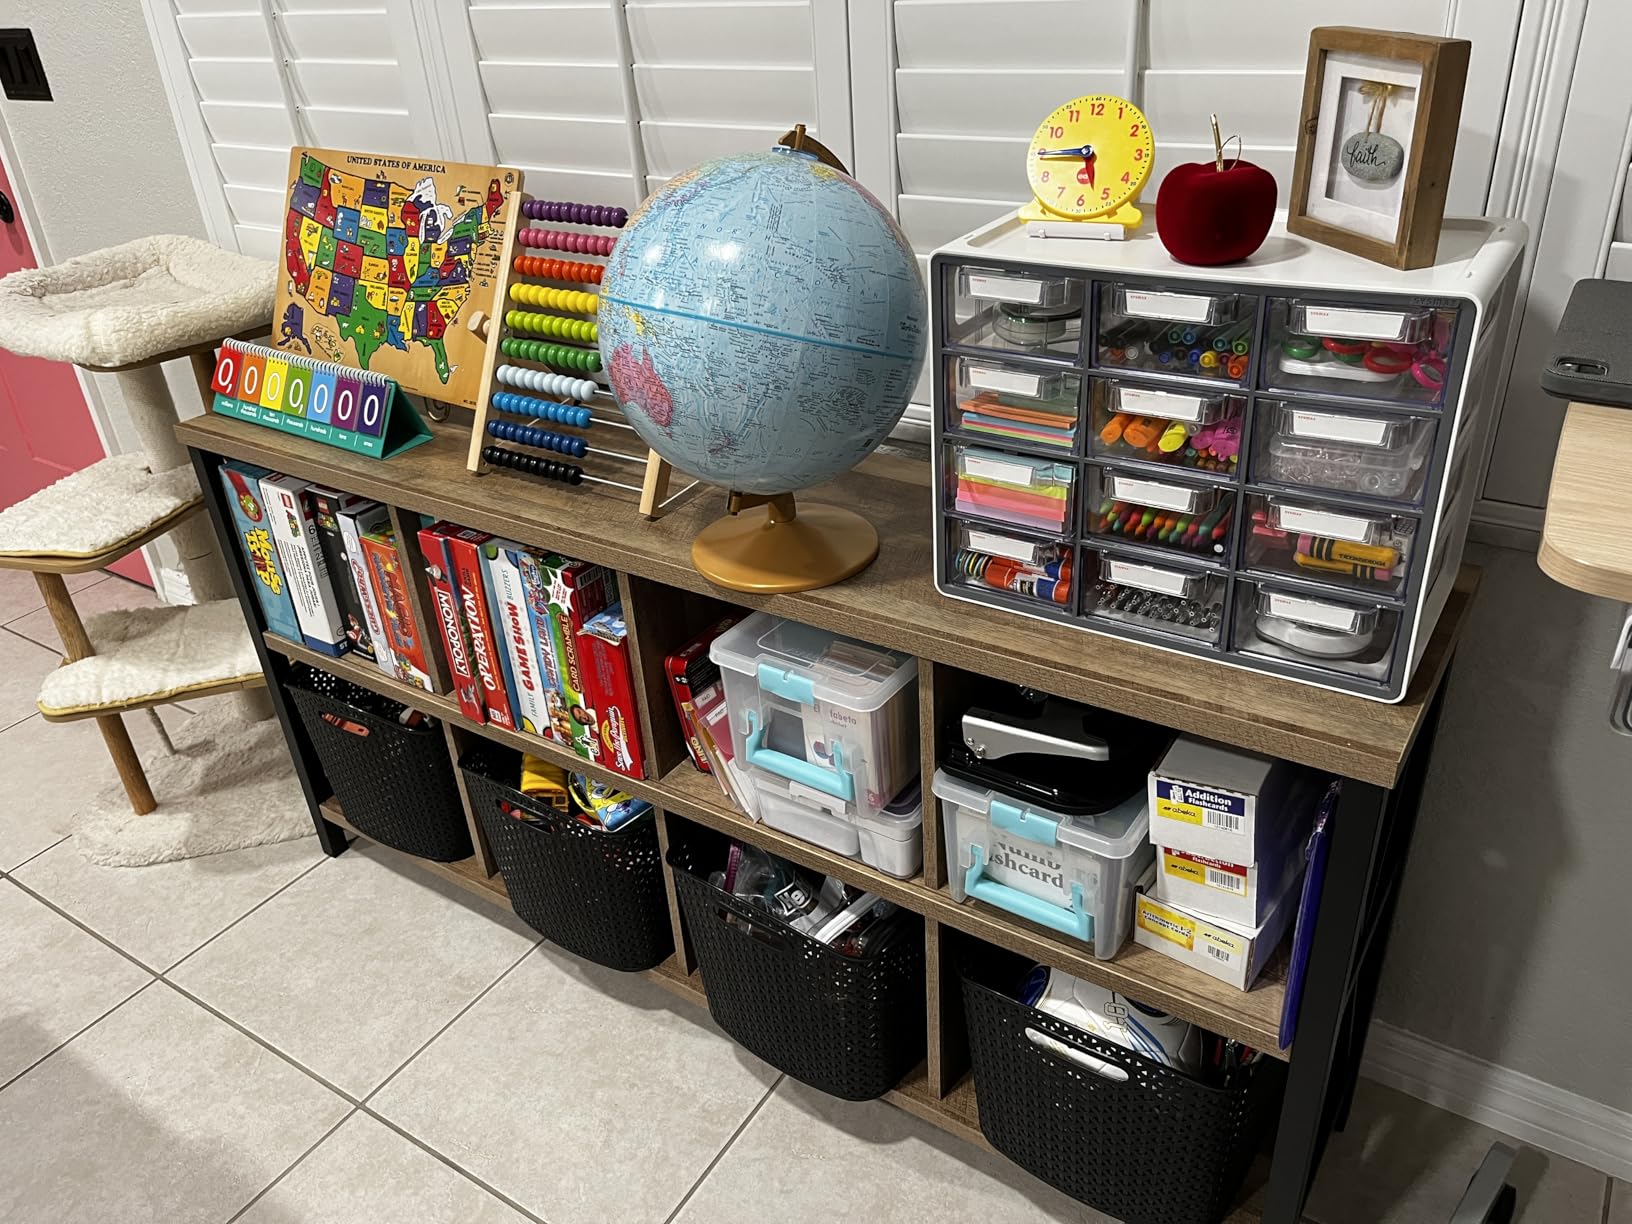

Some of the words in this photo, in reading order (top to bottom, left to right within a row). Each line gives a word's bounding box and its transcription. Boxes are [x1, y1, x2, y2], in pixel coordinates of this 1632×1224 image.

[1069, 110, 1080, 123] 11
[1090, 103, 1105, 116] 12
[1118, 107, 1123, 120] 1
[1049, 126, 1064, 139] 10
[1130, 124, 1139, 137] 2
[1134, 149, 1143, 161] 3
[1347, 141, 1386, 167] faith
[347, 155, 372, 166] UNITED
[373, 158, 400, 169] STATES
[401, 161, 410, 169] OF
[412, 163, 446, 173] AMERICA
[1041, 171, 1050, 183] 8
[1121, 171, 1130, 184] 4
[1057, 186, 1066, 199] 7
[1101, 188, 1110, 200] 5
[1076, 194, 1085, 207] 6
[244, 366, 258, 395] 0
[267, 372, 280, 401] 0
[314, 384, 328, 413] 0
[338, 390, 353, 421] 0
[363, 395, 379, 426] 0
[501, 569, 514, 601] BUZZERS
[507, 602, 526, 647] SHOW
[439, 593, 469, 676] MONOPOLY
[461, 583, 497, 691] OPERATION
[560, 614, 576, 664] SCRAMBLE
[517, 648, 535, 692] GAME
[567, 664, 581, 693] CARD
[529, 691, 538, 718] FAMILY
[1185, 789, 1232, 806] Addition
[1172, 807, 1197, 817] abeka
[1188, 798, 1229, 812] Flashcards
[1178, 866, 1199, 876] abeka
[1212, 935, 1236, 949] abeka
